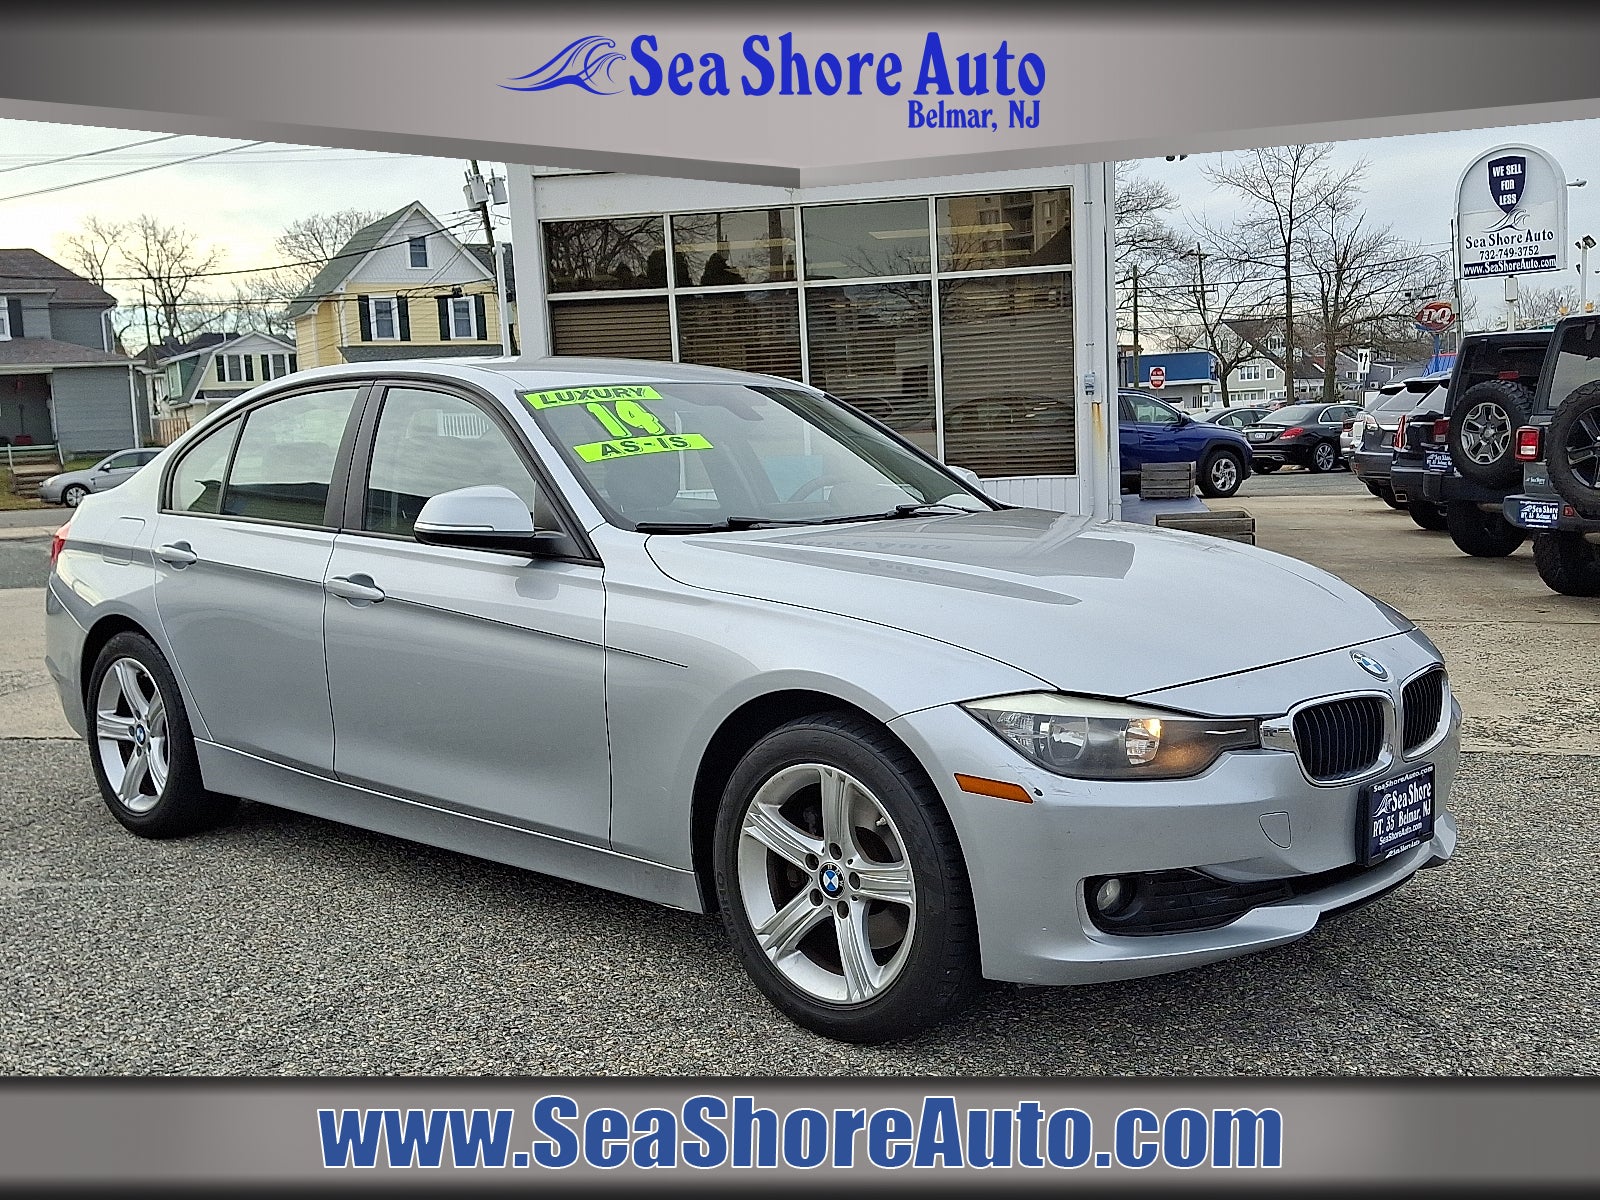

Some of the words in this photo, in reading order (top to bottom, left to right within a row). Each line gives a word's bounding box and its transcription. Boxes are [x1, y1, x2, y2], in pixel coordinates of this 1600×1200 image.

[1493, 165, 1505, 178] WE
[1506, 163, 1523, 176] SELL
[1500, 179, 1515, 191] FOR
[1499, 193, 1517, 206] LESS
[1465, 235, 1487, 250] Sea
[1488, 232, 1523, 247] Shore
[1525, 228, 1554, 243] Auto
[1479, 244, 1540, 261] 732-749-3752
[1464, 257, 1556, 276] www.SeaShoreAuto.com
[1421, 307, 1451, 325] DQ
[538, 386, 646, 406] LUXURY
[586, 400, 666, 438] 14
[600, 435, 691, 458] AS-IS
[1372, 765, 1434, 793] SeaShoreAuto.com
[1391, 790, 1408, 812] Sea
[1408, 781, 1432, 806] Shore
[1372, 818, 1385, 838] RT.
[1386, 814, 1395, 833] 35
[1398, 807, 1422, 828] Belmar,
[1422, 799, 1432, 818] NJ
[1379, 822, 1423, 846] SeaShoreAuto.com
